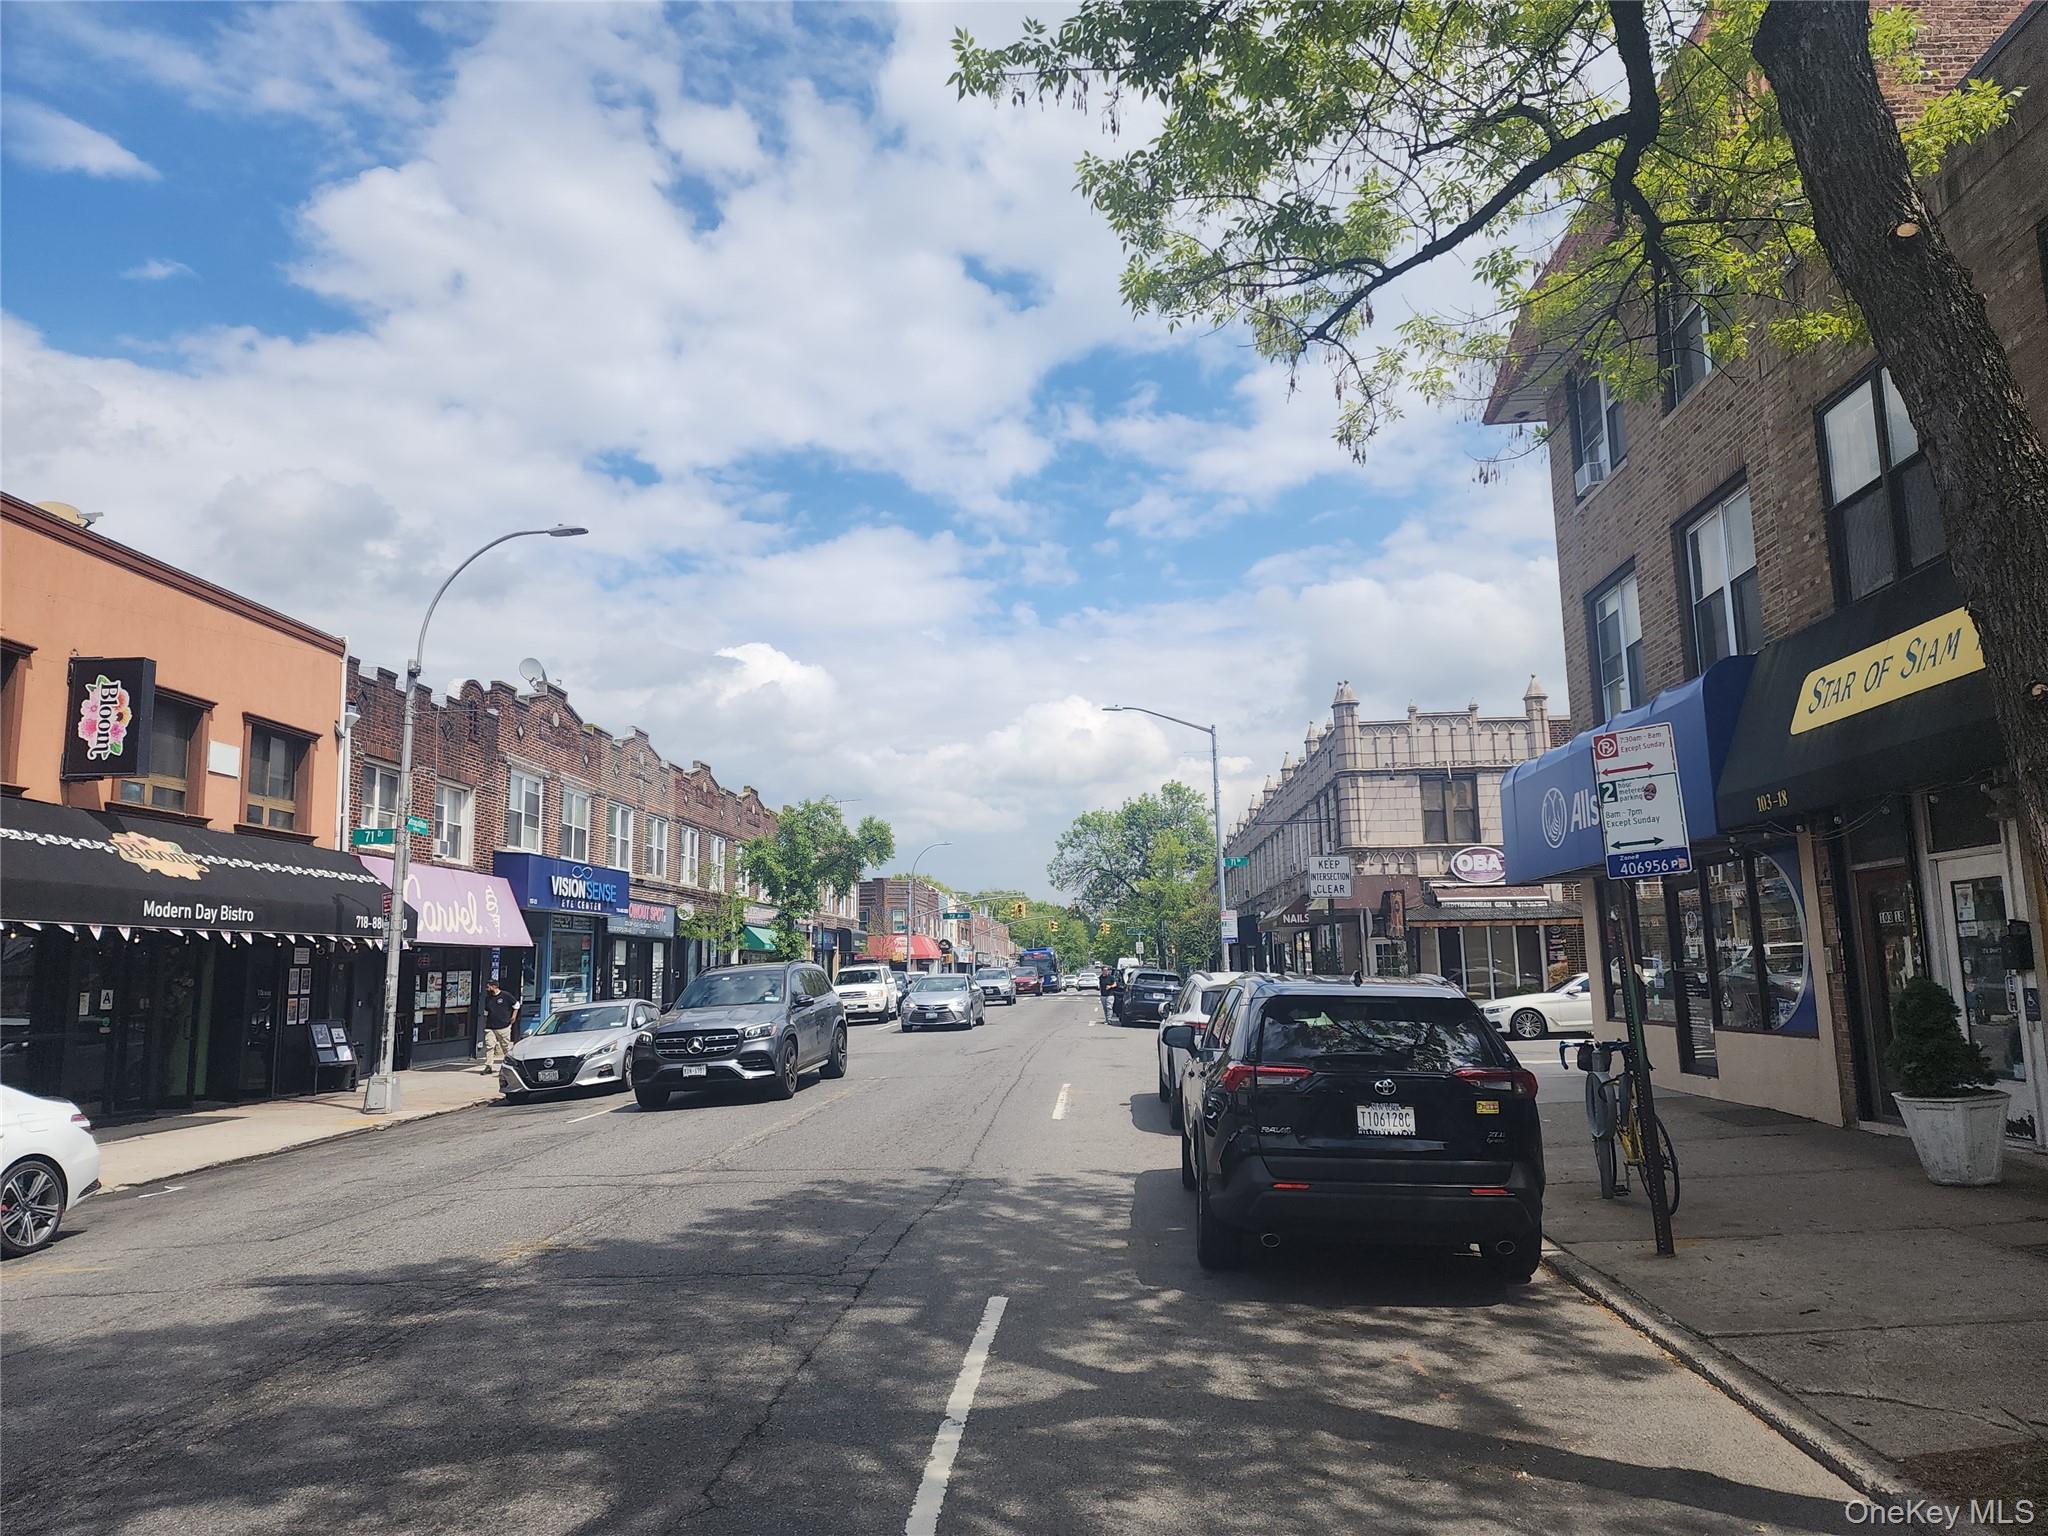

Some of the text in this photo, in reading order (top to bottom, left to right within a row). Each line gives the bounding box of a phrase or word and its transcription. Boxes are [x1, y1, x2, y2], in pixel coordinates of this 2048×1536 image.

[1863, 655, 1894, 693] OF
[90, 684, 119, 758] Bloom
[1620, 741, 1666, 753] Except Sunday
[1601, 782, 1616, 803] 2
[1618, 786, 1645, 795] metered
[1619, 793, 1643, 803] parking
[1756, 789, 1788, 812] 103-18
[1605, 811, 1621, 819] 8am
[1627, 808, 1643, 817] 7pm
[1606, 816, 1660, 828] Except Sunday
[364, 830, 384, 843] 71 Dr
[115, 842, 207, 870] Bloom
[1318, 860, 1340, 869] KEEP
[1456, 854, 1503, 872] OBA
[1620, 859, 1669, 875] 406956
[1310, 872, 1350, 881] INTERSECTION
[1316, 884, 1345, 894] CLEAR
[561, 898, 575, 909] EYE
[577, 900, 602, 911] CENTER
[143, 899, 254, 924] Modern Day Bistro
[1282, 913, 1310, 924] NAILS
[102, 992, 111, 1005] A
[1360, 1111, 1411, 1128] T106128C
